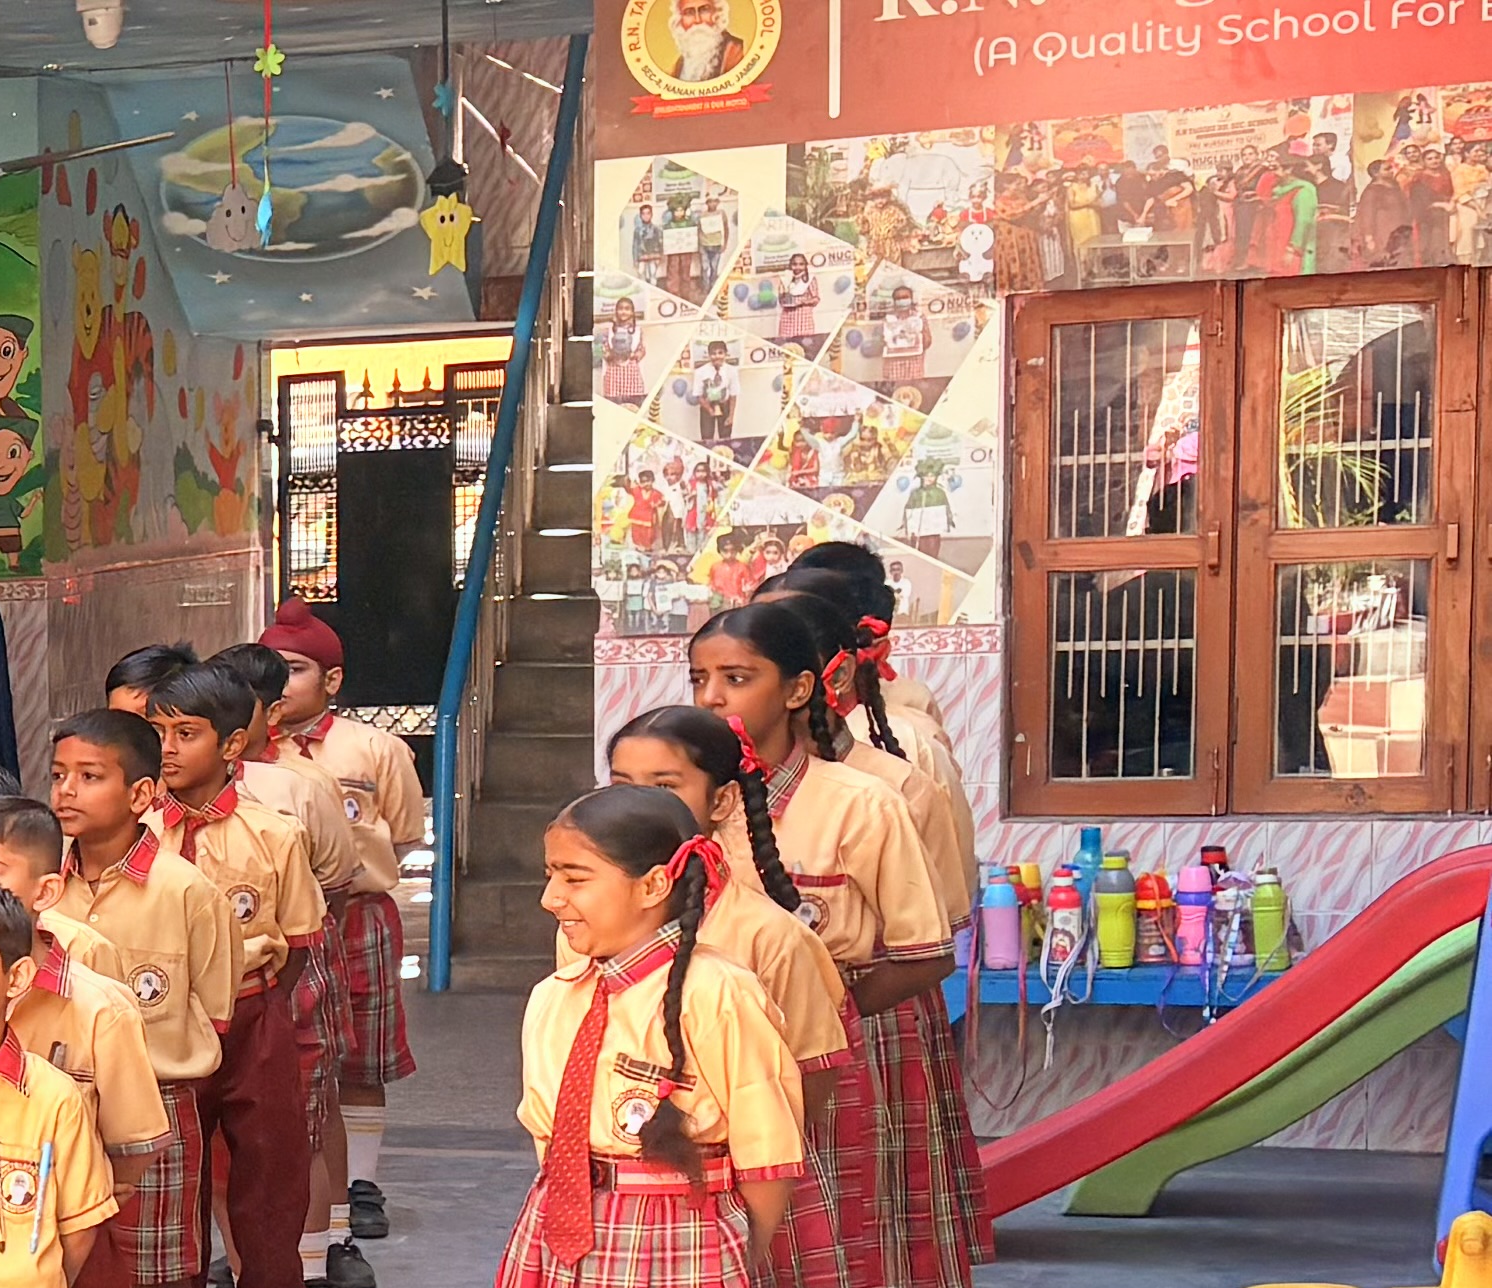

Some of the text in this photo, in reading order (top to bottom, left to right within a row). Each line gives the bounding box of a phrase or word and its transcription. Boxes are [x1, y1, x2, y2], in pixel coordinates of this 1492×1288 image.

[973, 36, 1017, 77] (A
[1033, 20, 1201, 68] Quality
[1217, 0, 1377, 46] School
[1391, 0, 1465, 29] For
